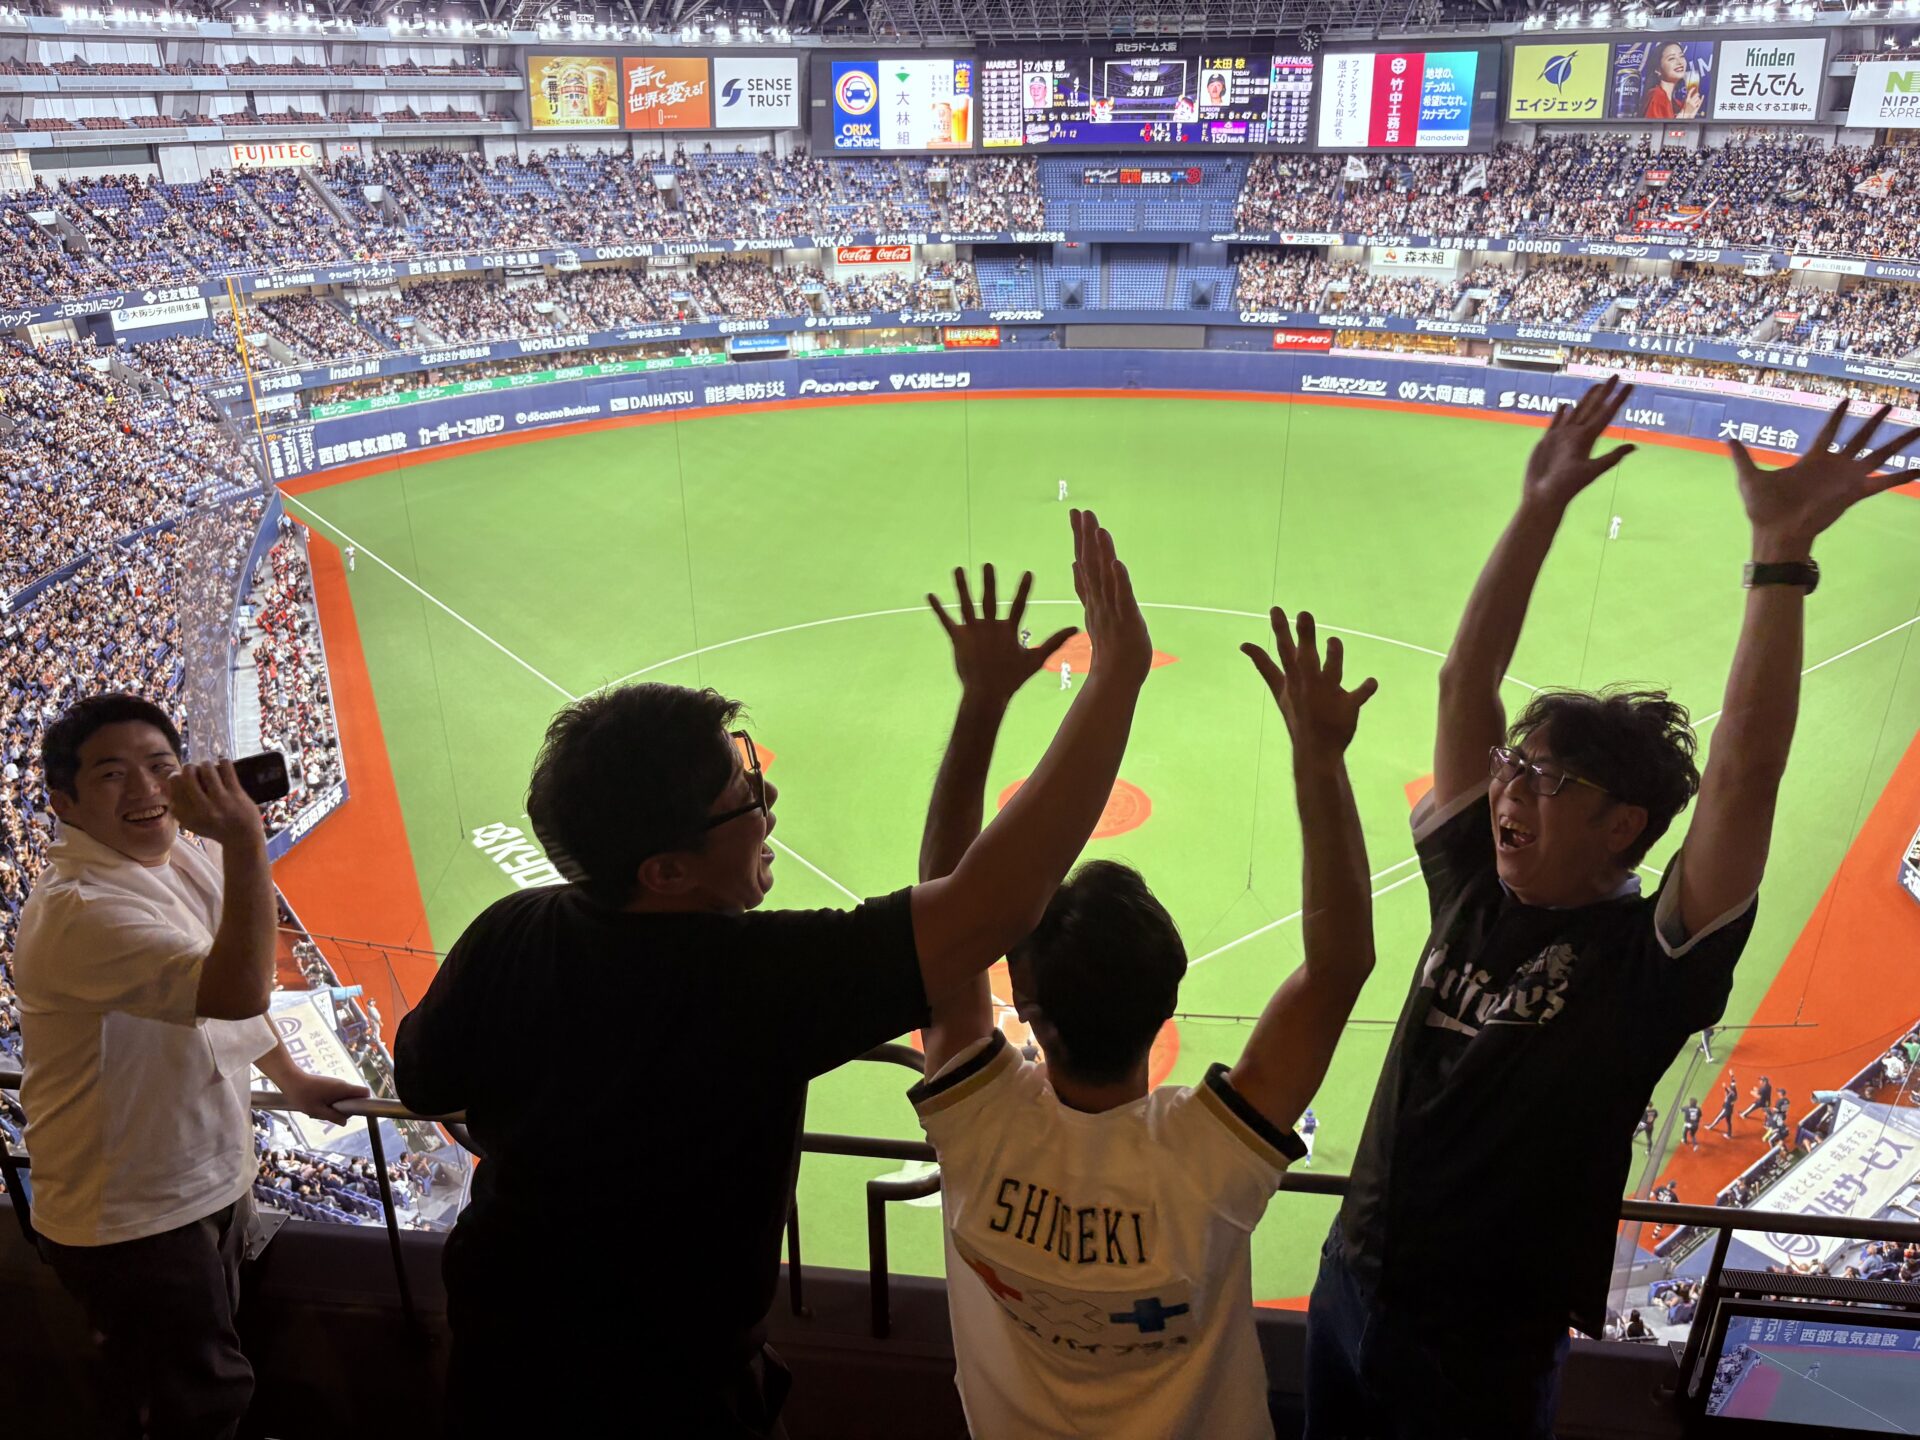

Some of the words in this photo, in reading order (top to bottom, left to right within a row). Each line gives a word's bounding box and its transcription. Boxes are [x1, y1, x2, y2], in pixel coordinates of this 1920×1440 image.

[1115, 43, 1159, 52] 京セラドーム
[1160, 42, 1177, 51] 大阪
[985, 60, 1017, 69] MARINES
[1212, 58, 1232, 69] 太田
[1275, 56, 1312, 64] BUFFALOES
[1746, 47, 1795, 67] Kinden
[1023, 61, 1033, 71] 37
[1426, 67, 1454, 80] 地球の、
[628, 65, 667, 95] 声で
[747, 78, 792, 91] SENSE
[1730, 72, 1804, 97] きんでん
[1127, 86, 1150, 97] .361
[748, 94, 791, 107] TRUST
[1515, 97, 1598, 112] エイジェック
[1718, 101, 1812, 113] 未来を良くする工事中。
[896, 91, 910, 145] 大林組
[1385, 78, 1405, 143] 竹中工務店
[843, 124, 871, 136] ORIX
[1420, 133, 1464, 142] Kanadevia
[835, 136, 880, 147] CarShare
[233, 143, 312, 165] FUJITEC
[747, 239, 795, 250] YOKOHAMA
[812, 236, 836, 248] YKK
[837, 235, 854, 247] AP
[1507, 239, 1561, 254] DOORDO
[596, 244, 653, 260] ONOCOM
[1588, 244, 1648, 257] 日本カルミック
[1686, 250, 1720, 262] フジタ
[1404, 252, 1444, 265] 森本組
[352, 265, 396, 280] テレネット
[408, 258, 466, 275] 西松建設
[157, 286, 200, 303] 住友電設
[63, 296, 124, 317] 日本カルミック
[519, 336, 565, 352] WORLD
[566, 334, 589, 347] EYE
[1640, 337, 1694, 354] SAIKI
[329, 363, 363, 381] Inada
[555, 367, 583, 380] SENKO
[600, 362, 628, 374] センコー
[260, 374, 303, 392] 村本建設
[463, 380, 492, 393] SENKO
[510, 374, 539, 385] センコー
[800, 380, 879, 394] Pioneer
[1302, 375, 1388, 392] リーガルマンション
[416, 387, 445, 400] センコー
[630, 391, 694, 409] DAIHATSU
[704, 381, 786, 404] 能美防災
[1420, 384, 1486, 406] 大岡産業
[371, 394, 400, 407] SENKO
[564, 405, 601, 418] Business
[1626, 408, 1665, 426] LIXIL
[418, 414, 505, 445] カーポートマルゼン
[1718, 419, 1799, 450] 大同生命
[318, 432, 407, 465] 西部電気建設
[989, 1177, 1147, 1265] SHIGEKI
[1800, 1328, 1899, 1347] 西部電気建設
